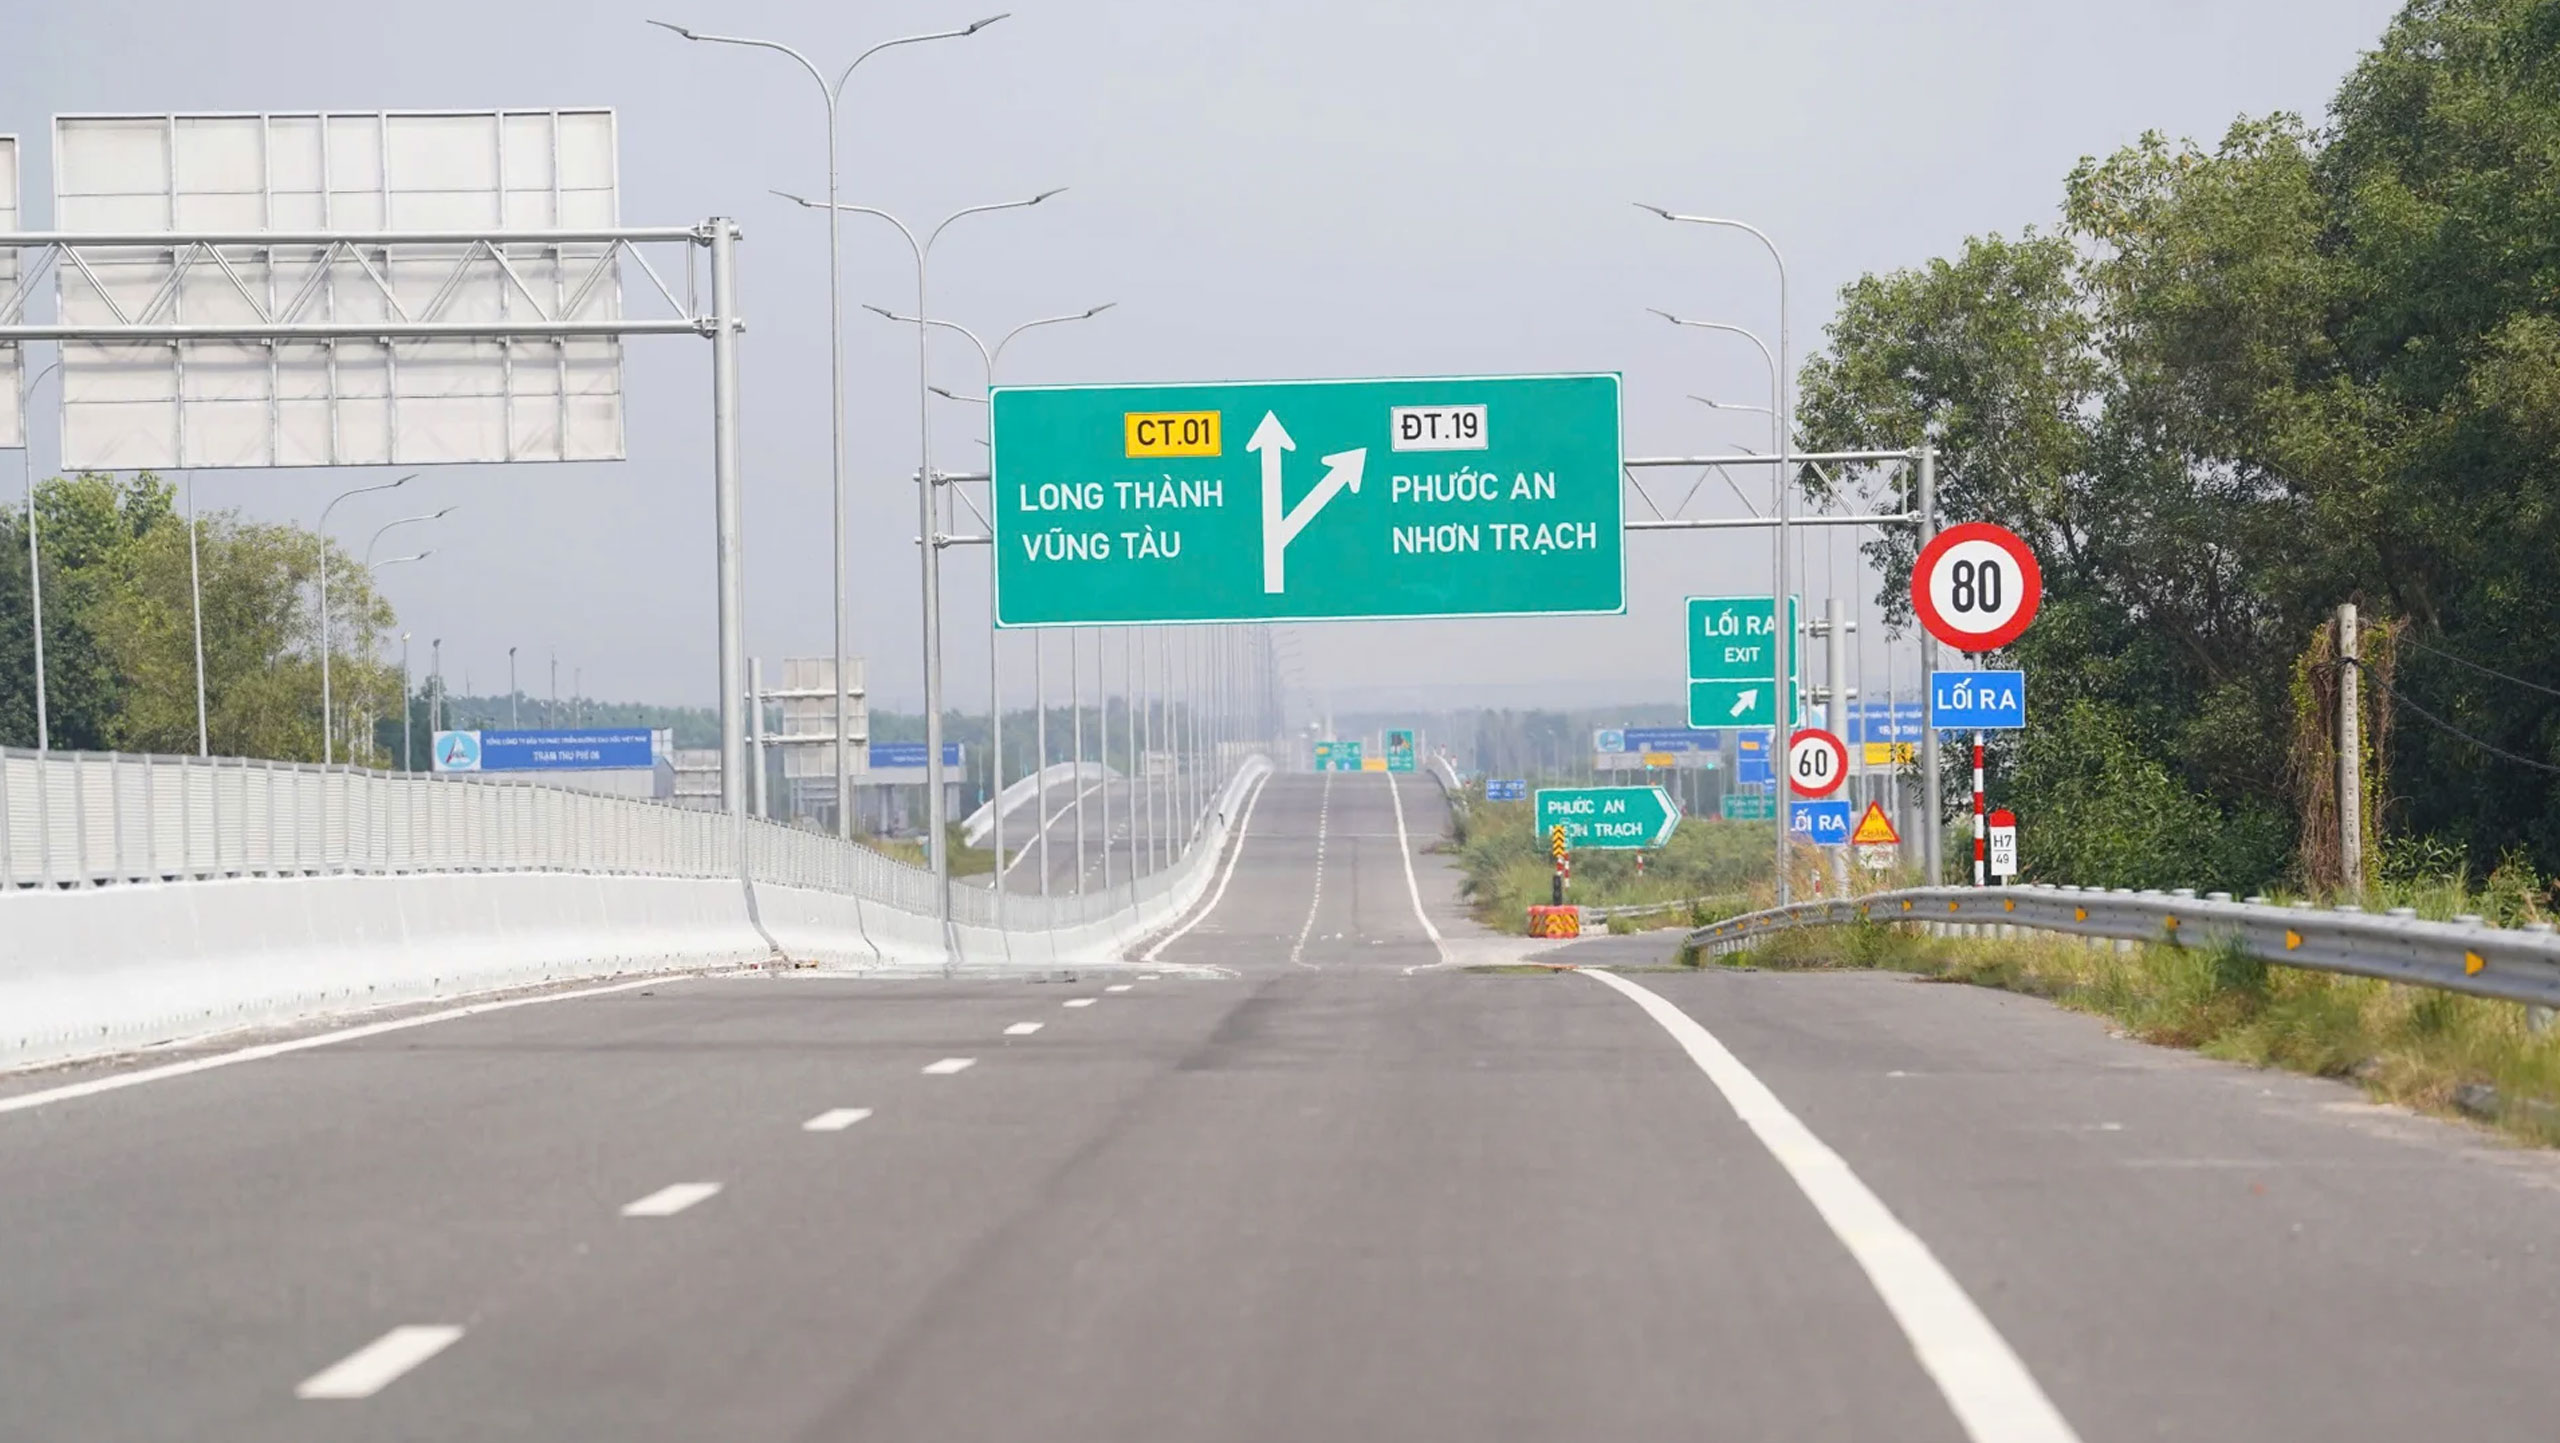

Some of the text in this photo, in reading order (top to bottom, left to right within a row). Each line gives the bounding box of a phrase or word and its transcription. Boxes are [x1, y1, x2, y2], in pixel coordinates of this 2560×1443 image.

[1137, 418, 1211, 446] CT.01
[1401, 412, 1478, 441] ĐT.19
[1020, 473, 1223, 512] LONG THÀNH
[1392, 465, 1556, 503] PHƯỚC AN
[1022, 524, 1181, 562] VŨNG TÀU
[1392, 522, 1597, 555] NHƠN TRẠCH
[1952, 559, 2002, 614] 80
[1704, 608, 1739, 637] LỐI
[1724, 646, 1761, 663] EXIT
[1937, 678, 2017, 710] LỐI RA
[1799, 748, 1828, 777] 60
[1547, 796, 1625, 815] PHƯỚC AN
[1790, 808, 1846, 831] ỐI RA
[1595, 821, 1643, 839] TRẠCH
[1993, 834, 2012, 848] H7
[1996, 853, 2010, 864] 49
